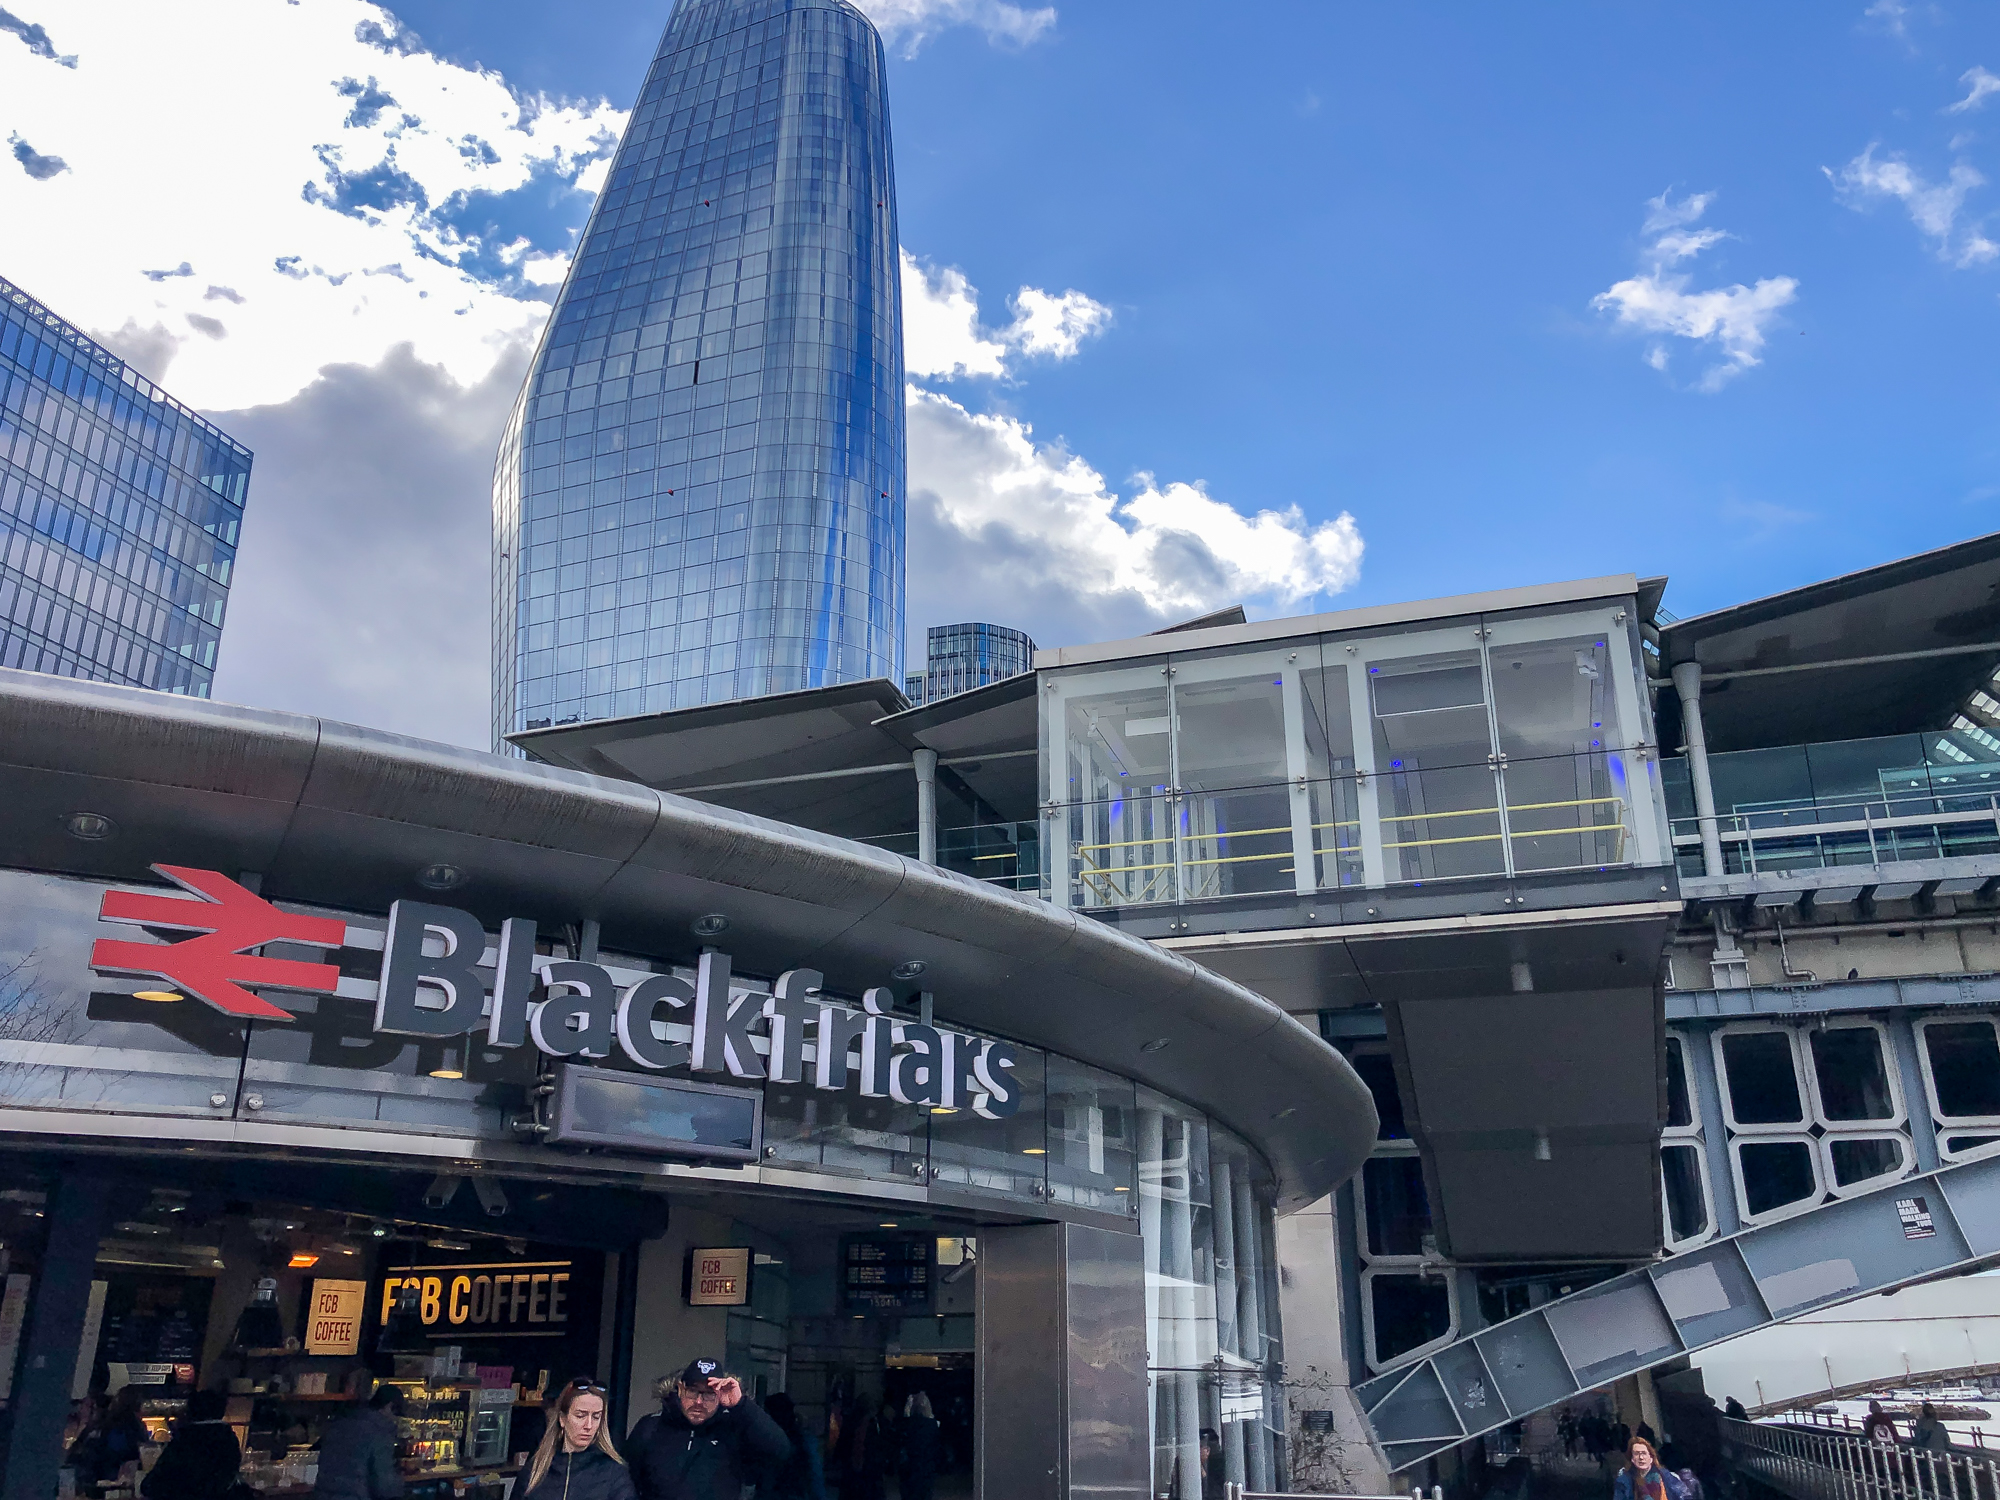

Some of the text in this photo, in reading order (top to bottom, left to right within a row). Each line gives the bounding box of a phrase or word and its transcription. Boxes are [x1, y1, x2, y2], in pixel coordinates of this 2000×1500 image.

[374, 900, 1018, 1119] Blackfriars
[1901, 1213, 1931, 1222] WALKING
[702, 1260, 721, 1274] FCB
[700, 1279, 737, 1294] COFFEE
[319, 1294, 339, 1313] FCB
[449, 1273, 570, 1325] COFFEE
[315, 1321, 353, 1341] COFFEE
